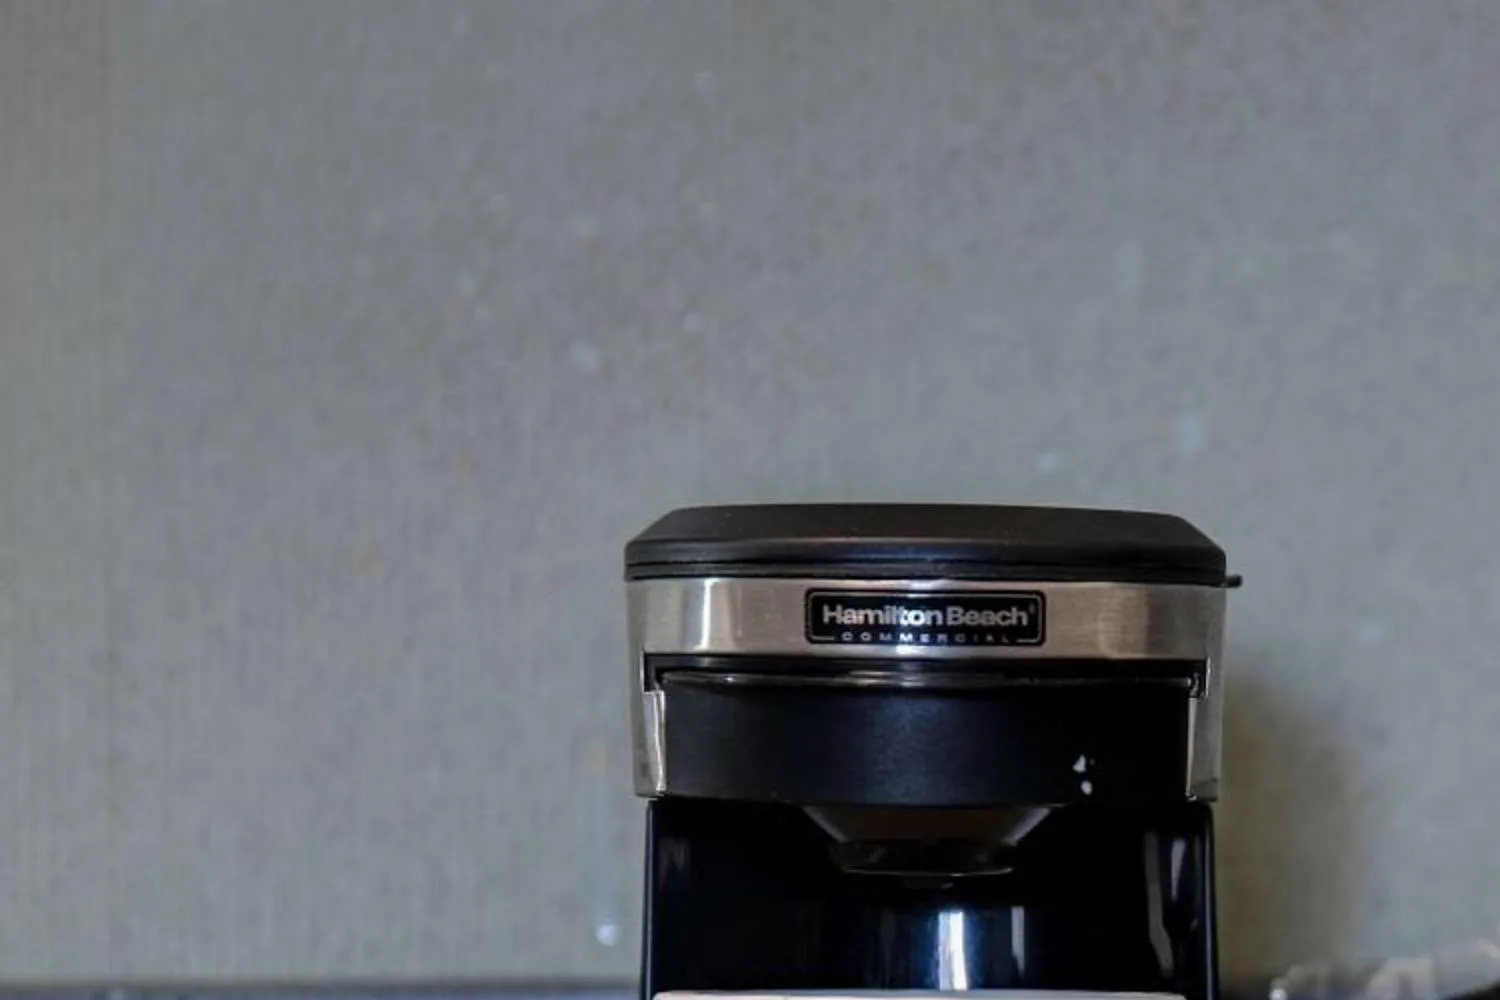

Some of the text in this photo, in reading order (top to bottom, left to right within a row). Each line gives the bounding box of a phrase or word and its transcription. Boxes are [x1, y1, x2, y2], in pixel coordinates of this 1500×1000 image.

[822, 604, 1029, 627] Hamilton Beach
[841, 631, 1009, 644] COMMERCIAL
